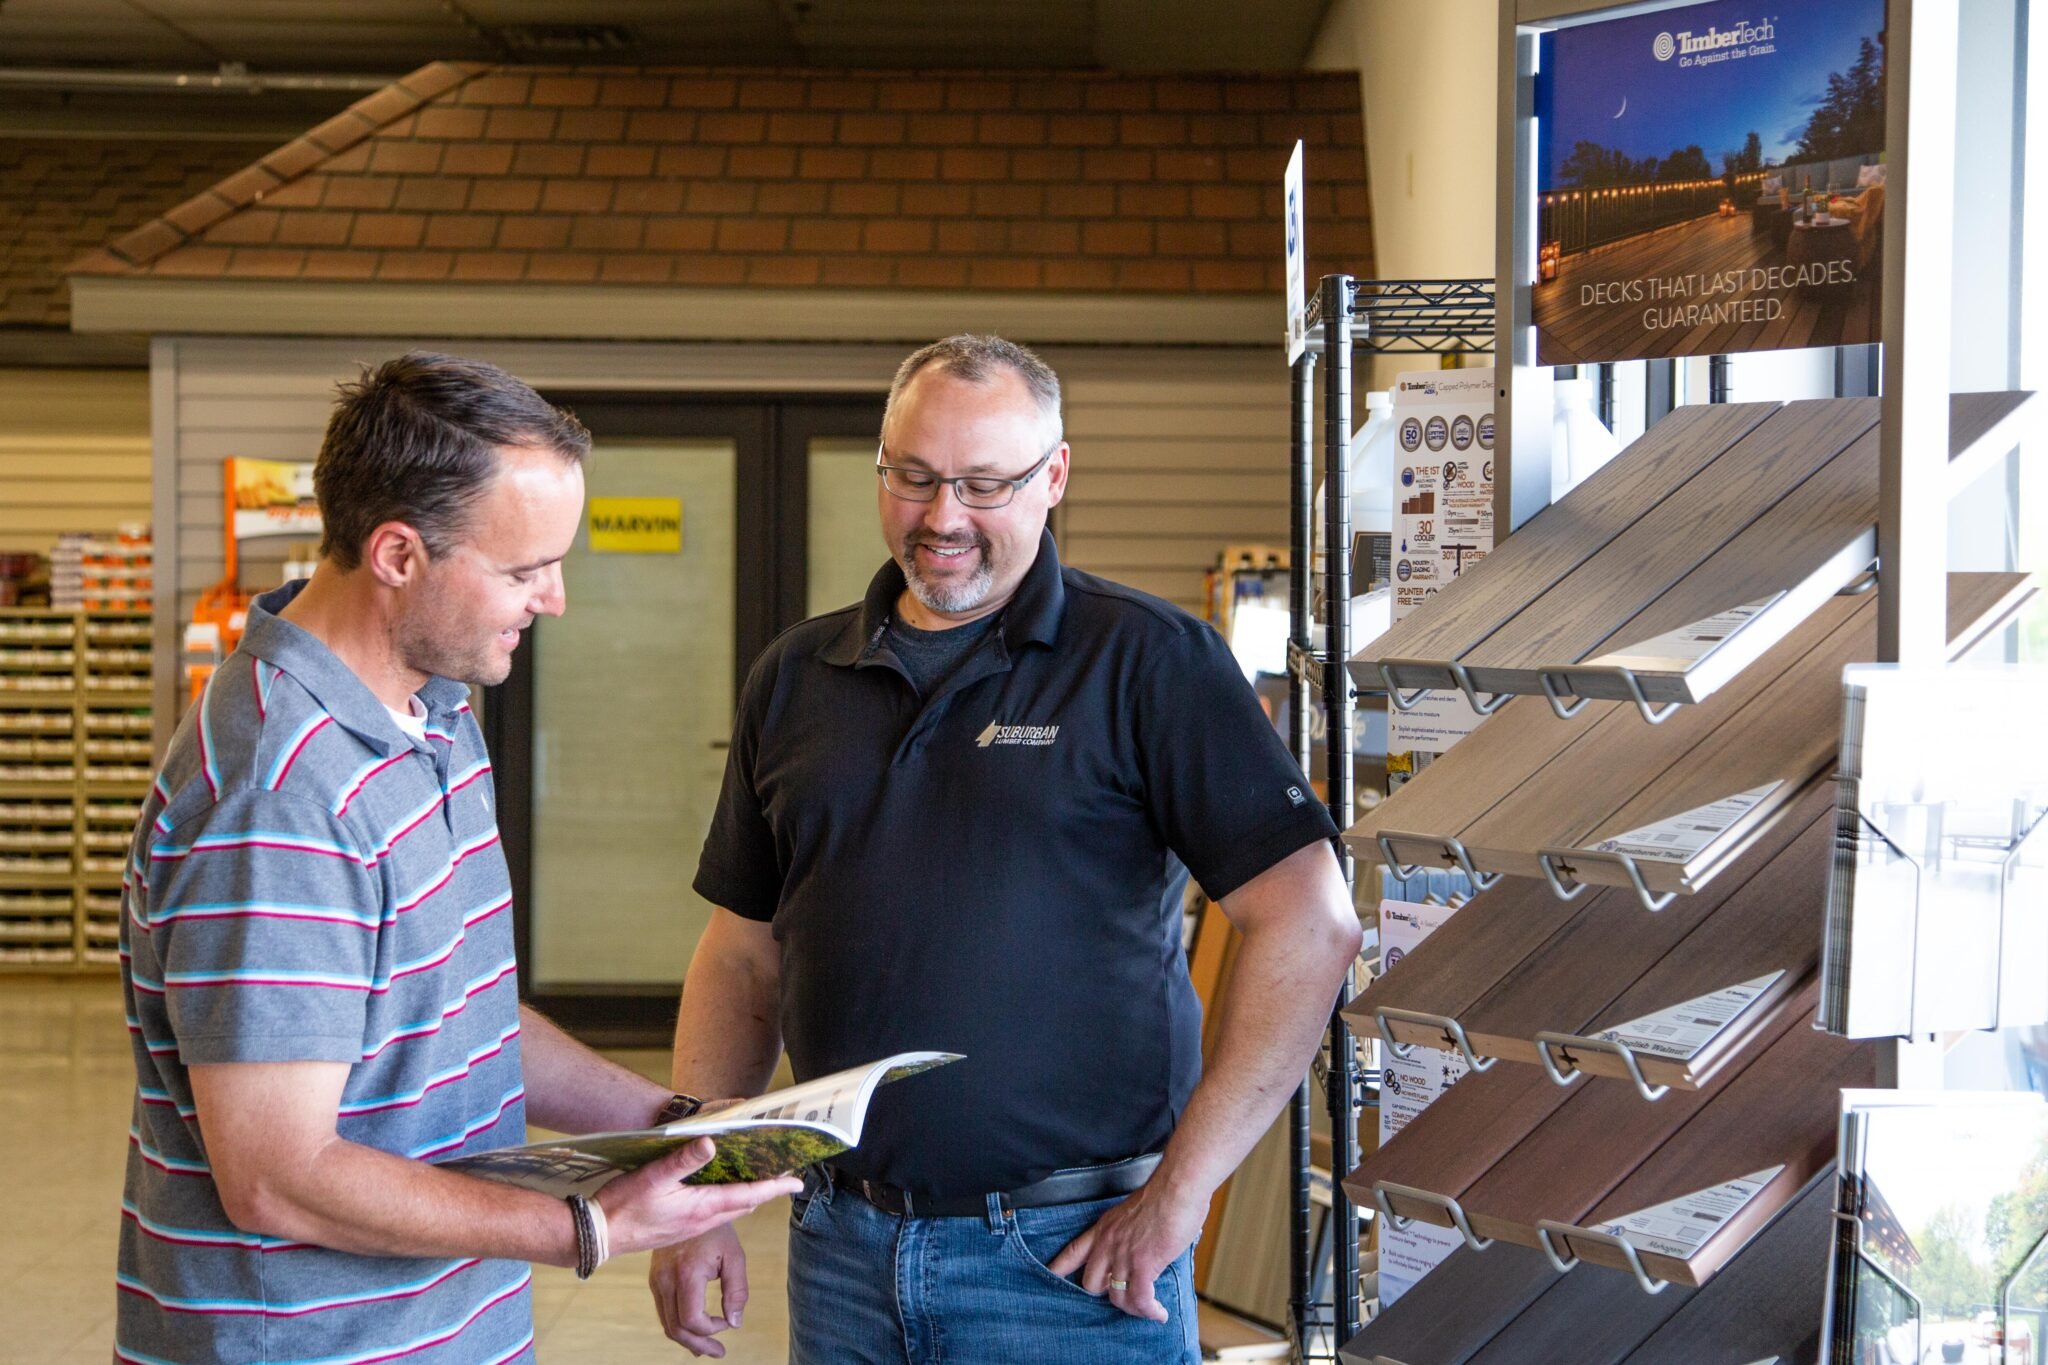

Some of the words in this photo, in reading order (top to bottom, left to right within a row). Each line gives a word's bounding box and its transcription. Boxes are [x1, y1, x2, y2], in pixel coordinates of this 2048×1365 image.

[1677, 18, 1775, 55] TimberTech
[1680, 57, 1692, 68] Go
[1694, 51, 1729, 66] Against
[1731, 48, 1747, 60] the
[1748, 43, 1777, 57] Grain.
[1580, 279, 1644, 307] DECKS
[1648, 275, 1697, 300] THAT
[1700, 270, 1747, 297] LAST
[1751, 259, 1858, 292] DECADES.
[1642, 297, 1786, 330] GUARANTEED.
[1482, 379, 1495, 390] Dec
[1405, 429, 1418, 440] 50
[1416, 466, 1429, 476] THE
[1430, 466, 1440, 475] 1ST
[1457, 481, 1475, 489] WOOD
[591, 515, 681, 532] MARVIN
[1413, 534, 1436, 542] COOLER
[1442, 550, 1456, 560] 30%
[1461, 550, 1487, 560] LIGHTER
[1397, 587, 1424, 596] SPLINTER
[1397, 597, 1412, 606] FREE
[997, 725, 1059, 739] SUBURBAN
[1022, 738, 1057, 746] COMPANY
[1617, 1038, 1650, 1049] English
[1400, 1074, 1409, 1082] NO
[1409, 1076, 1426, 1086] WOOD
